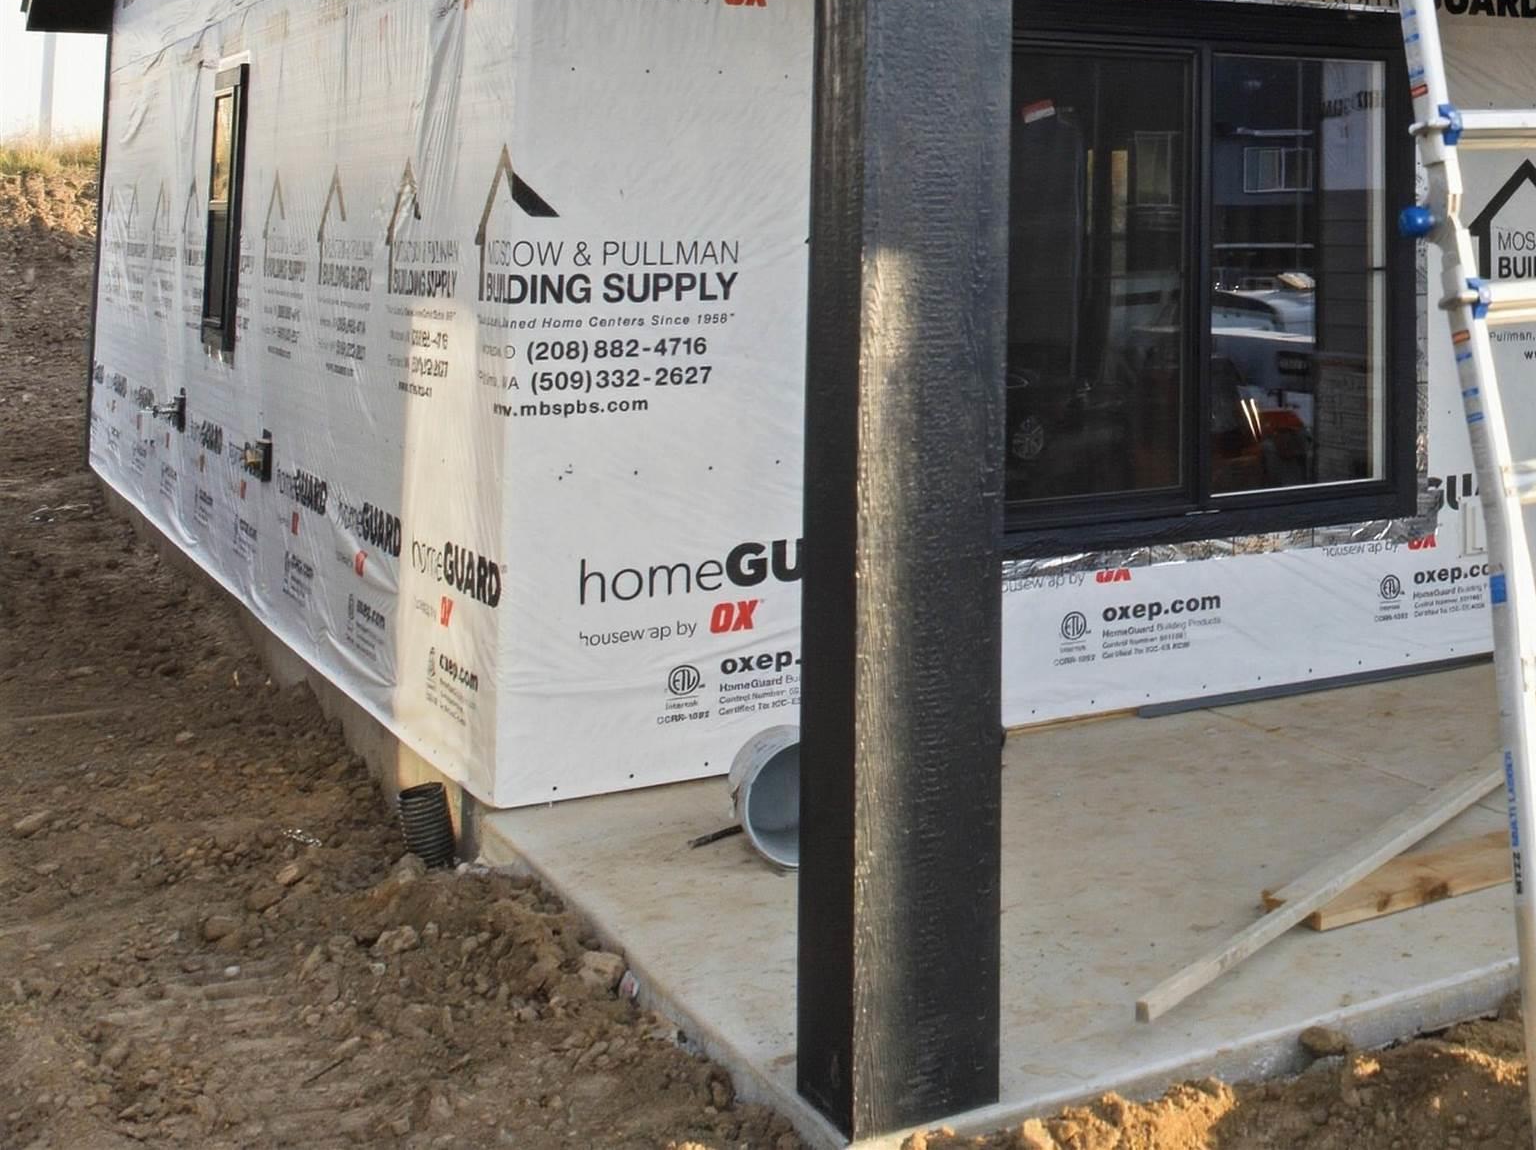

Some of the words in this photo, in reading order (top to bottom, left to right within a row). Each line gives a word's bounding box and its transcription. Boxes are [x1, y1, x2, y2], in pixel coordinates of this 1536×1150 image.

[573, 241, 592, 267] &
[602, 240, 740, 267] PULLMAN
[602, 272, 739, 303] SUPPLY
[542, 316, 583, 328] Home
[589, 315, 646, 328] Centers
[651, 313, 691, 326] Since
[676, 620, 698, 639] by
[710, 601, 758, 634] OX
[1102, 594, 1221, 623] oxep.com
